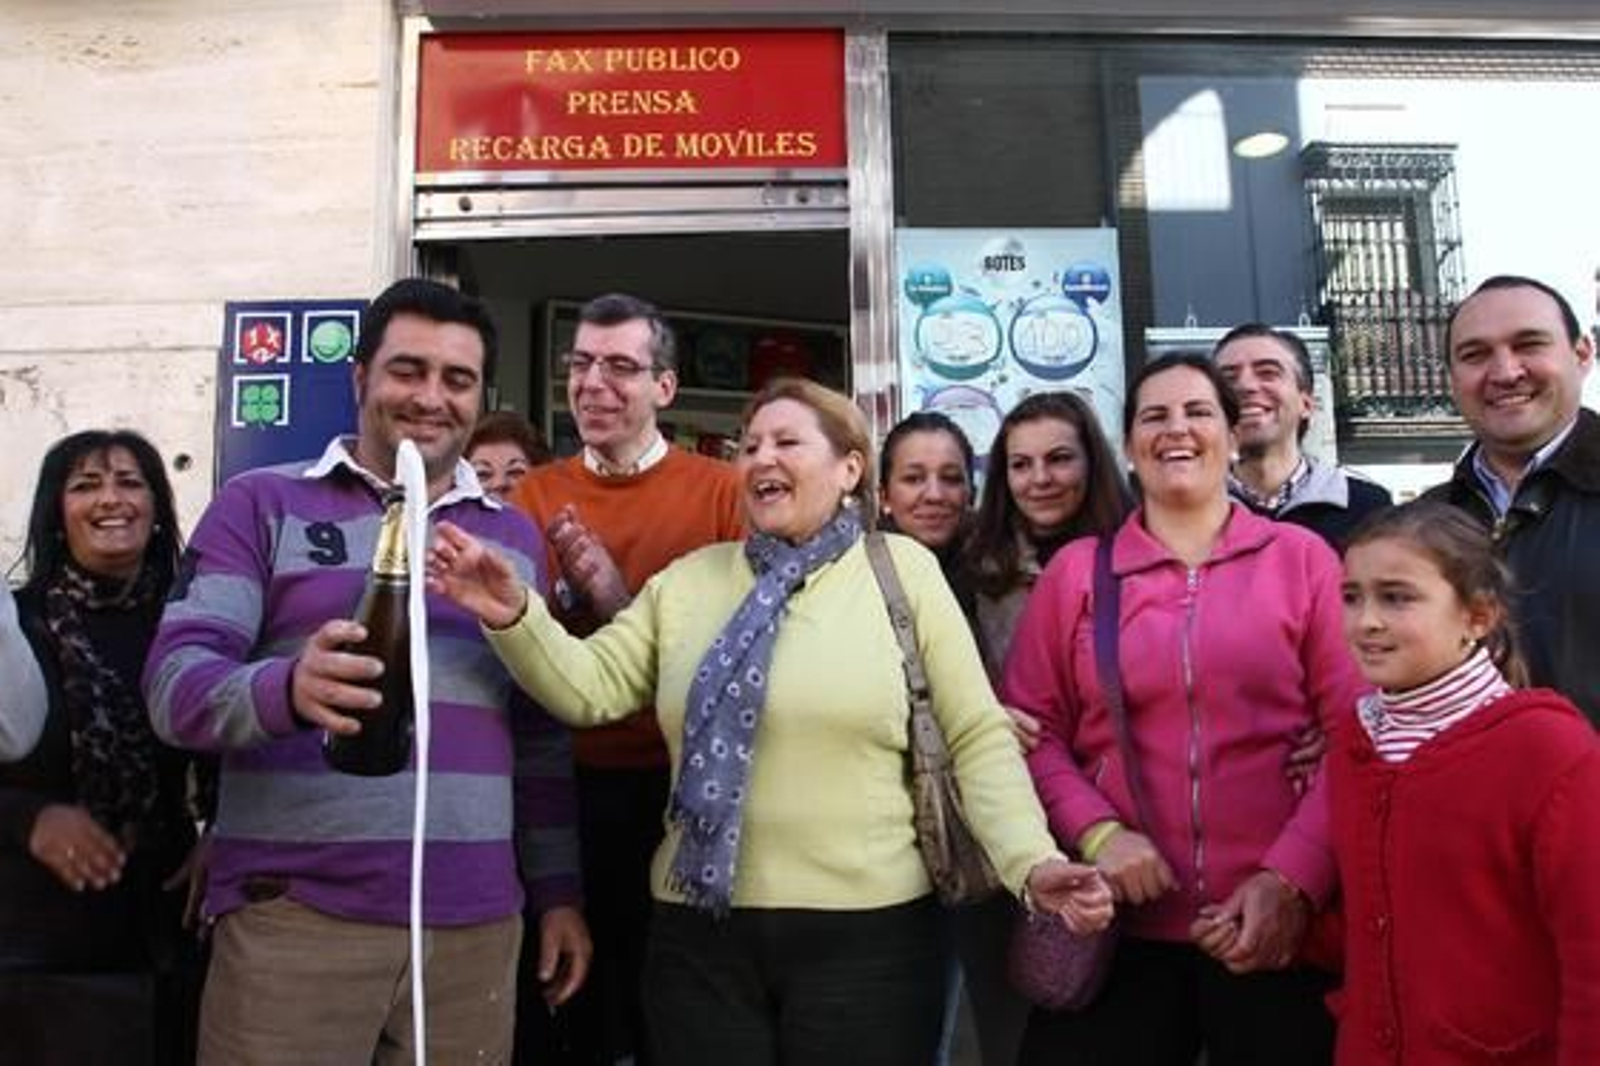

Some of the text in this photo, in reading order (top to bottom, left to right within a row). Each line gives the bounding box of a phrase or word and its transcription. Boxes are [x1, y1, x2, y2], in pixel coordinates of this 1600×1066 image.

[525, 47, 741, 73] FAX PUBLICO
[567, 90, 699, 115] PRENSA
[450, 130, 818, 161] RECARGA DE MOVILES
[305, 521, 348, 566] 9
